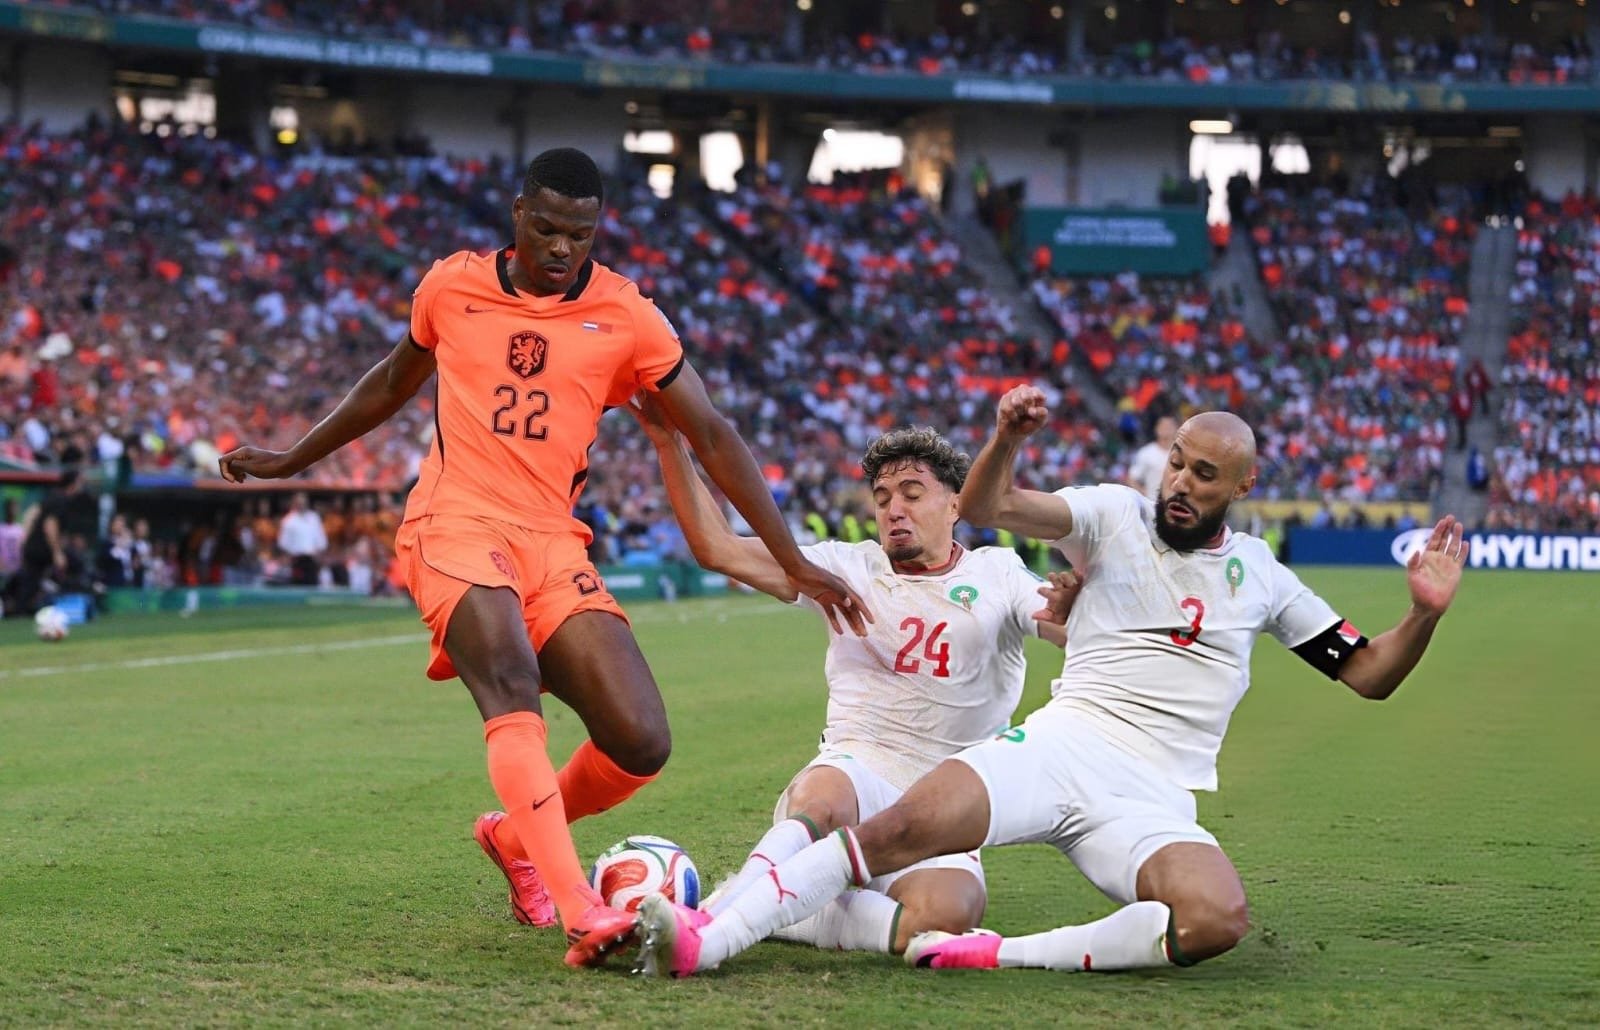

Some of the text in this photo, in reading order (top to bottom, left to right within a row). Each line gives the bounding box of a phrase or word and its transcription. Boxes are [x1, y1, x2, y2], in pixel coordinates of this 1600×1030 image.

[492, 384, 549, 441] 22
[573, 571, 606, 597] 2
[895, 616, 950, 678] 24
[1170, 596, 1205, 647] 3
